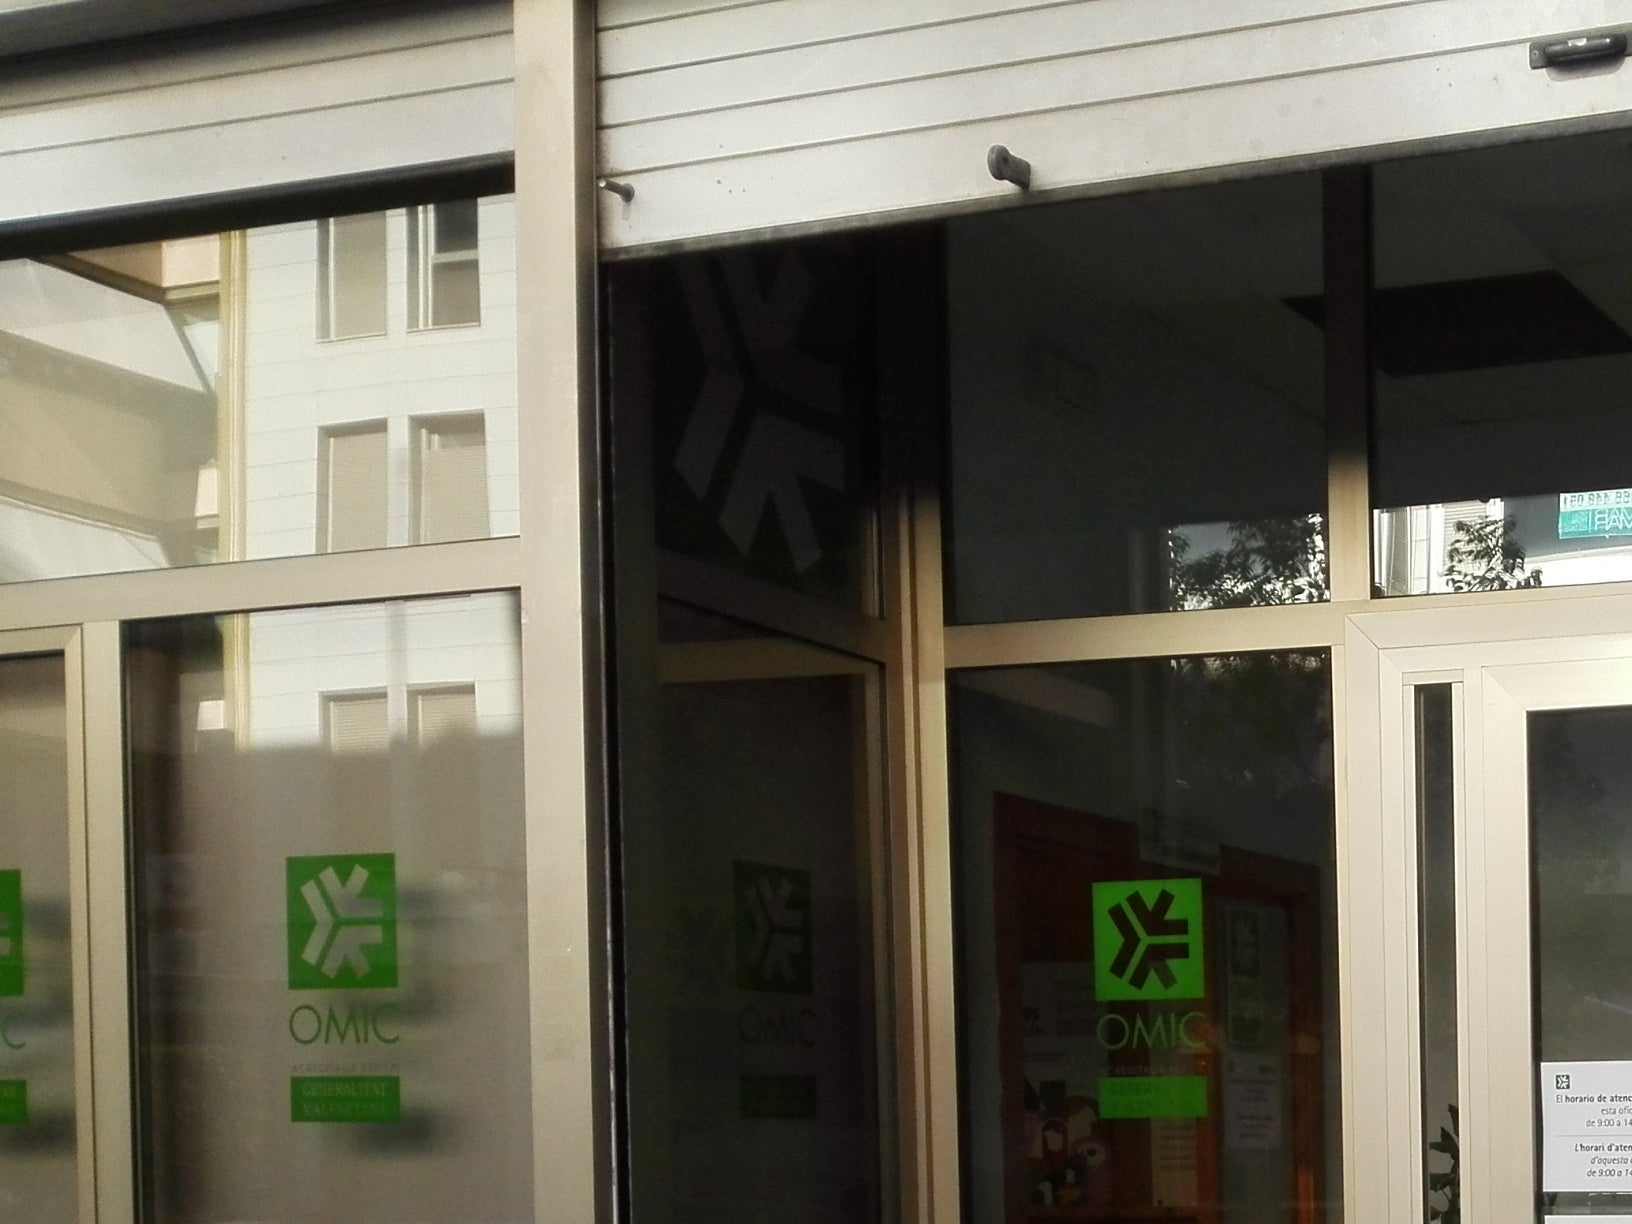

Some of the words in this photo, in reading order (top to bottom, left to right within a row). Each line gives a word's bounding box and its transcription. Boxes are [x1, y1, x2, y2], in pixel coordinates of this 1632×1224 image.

[289, 1003, 399, 1045] OMIC
[1096, 1011, 1207, 1050] OMIC
[1556, 1094, 1563, 1103] El
[1565, 1094, 1595, 1103] horario
[1597, 1094, 1607, 1102] de
[1600, 1107, 1617, 1115] esta
[1586, 1119, 1595, 1127] de
[1597, 1118, 1615, 1127] 9:00
[1590, 1156, 1628, 1166] d'aquesta
[1587, 1169, 1596, 1177] de
[1598, 1168, 1616, 1177] 9:00
